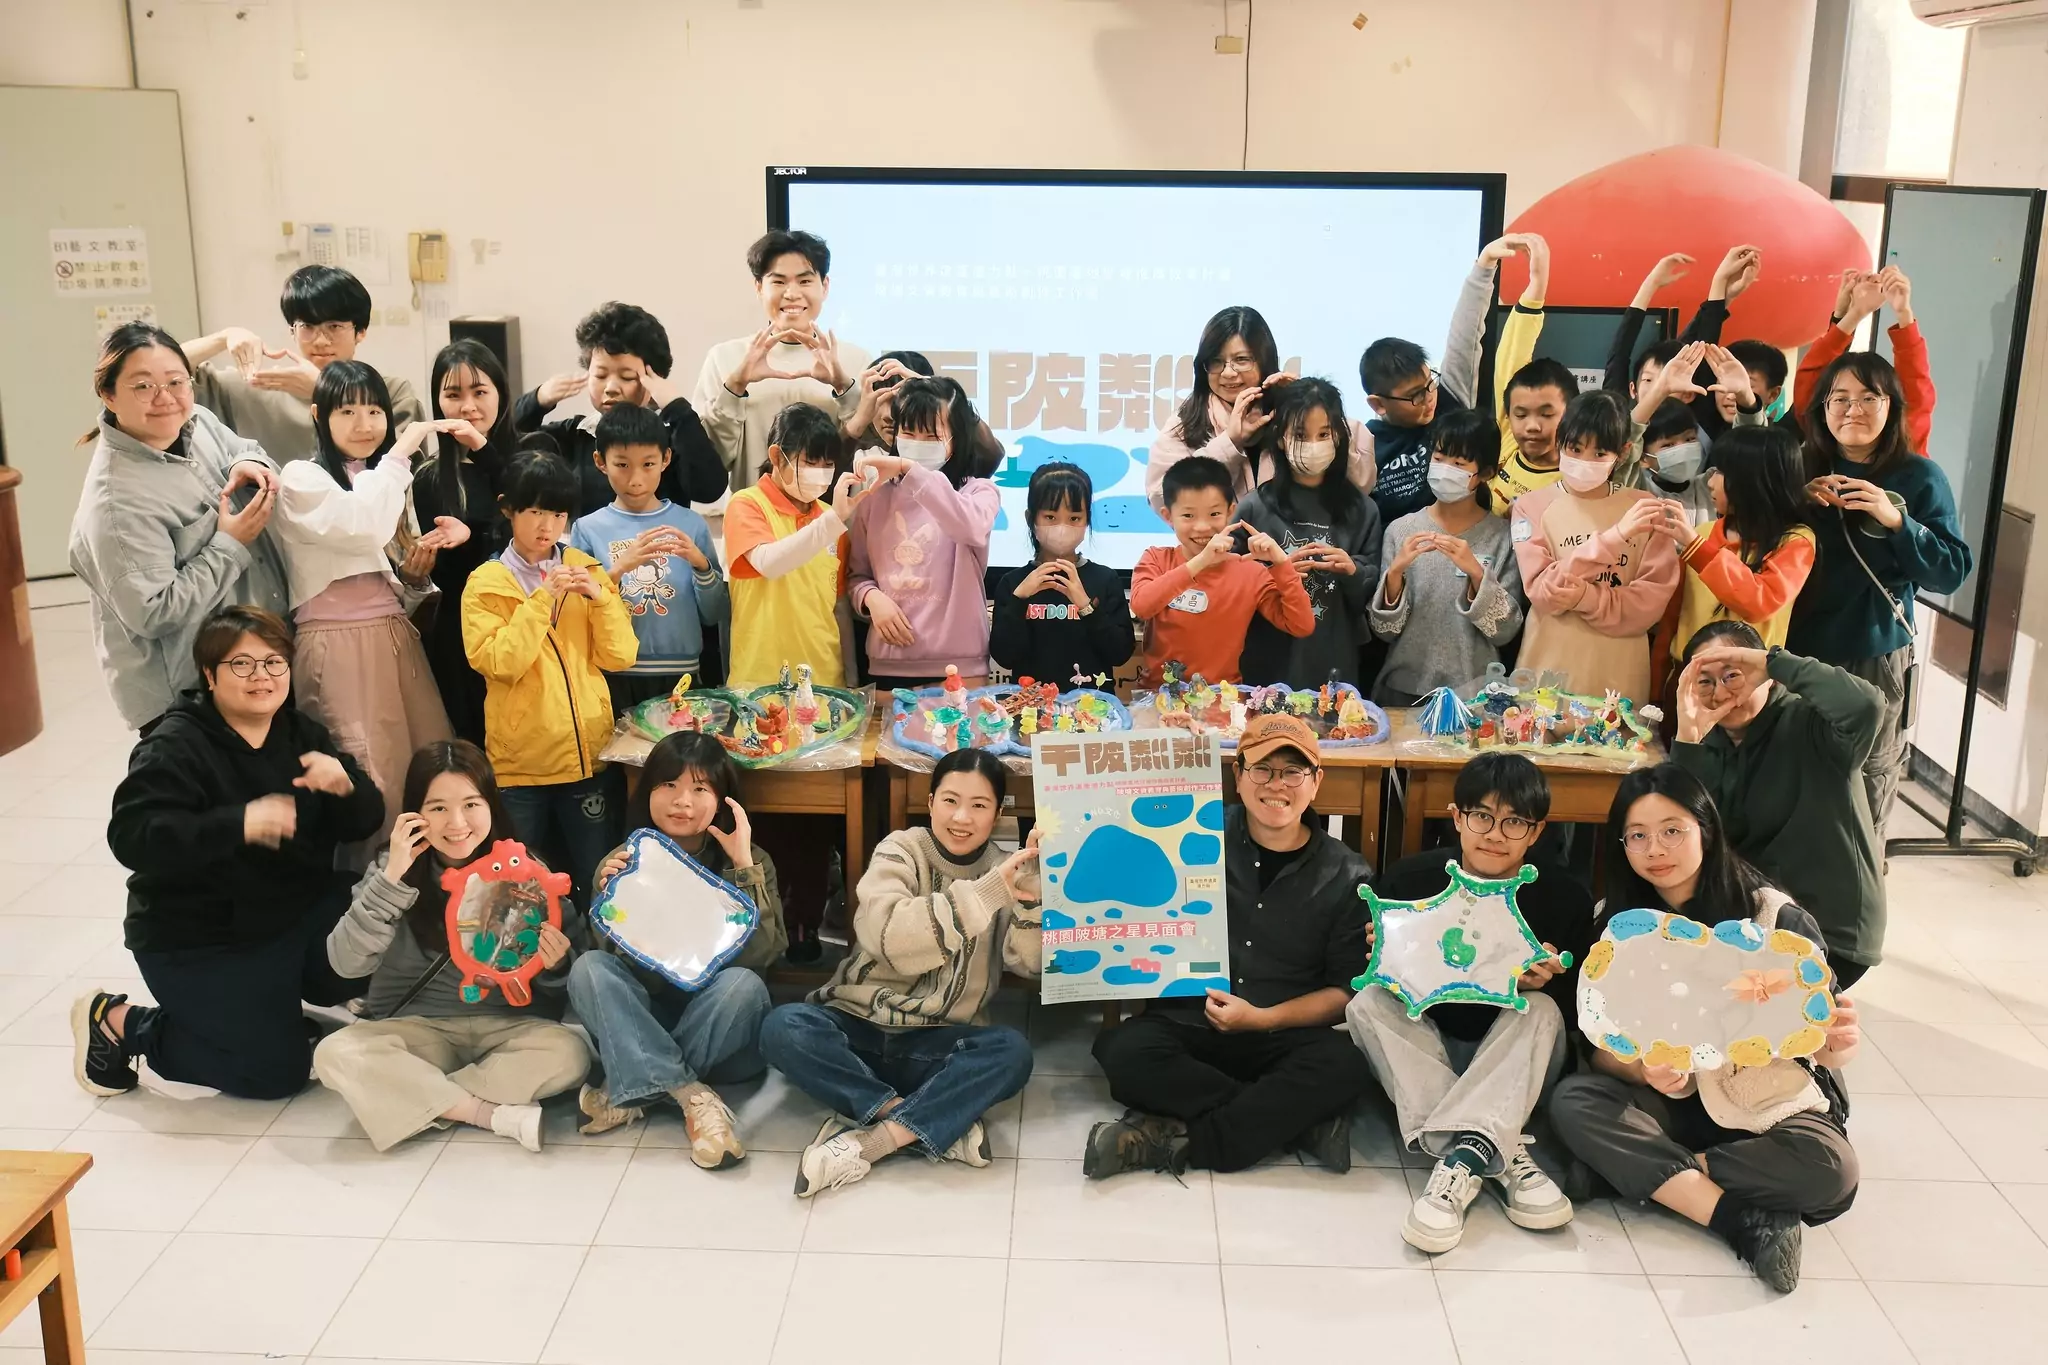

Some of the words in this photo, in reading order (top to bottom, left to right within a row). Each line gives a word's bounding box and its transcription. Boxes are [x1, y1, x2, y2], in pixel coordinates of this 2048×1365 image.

[1046, 603, 1068, 620] DO
[1041, 920, 1197, 946] 桃園陂塘之星見面會
